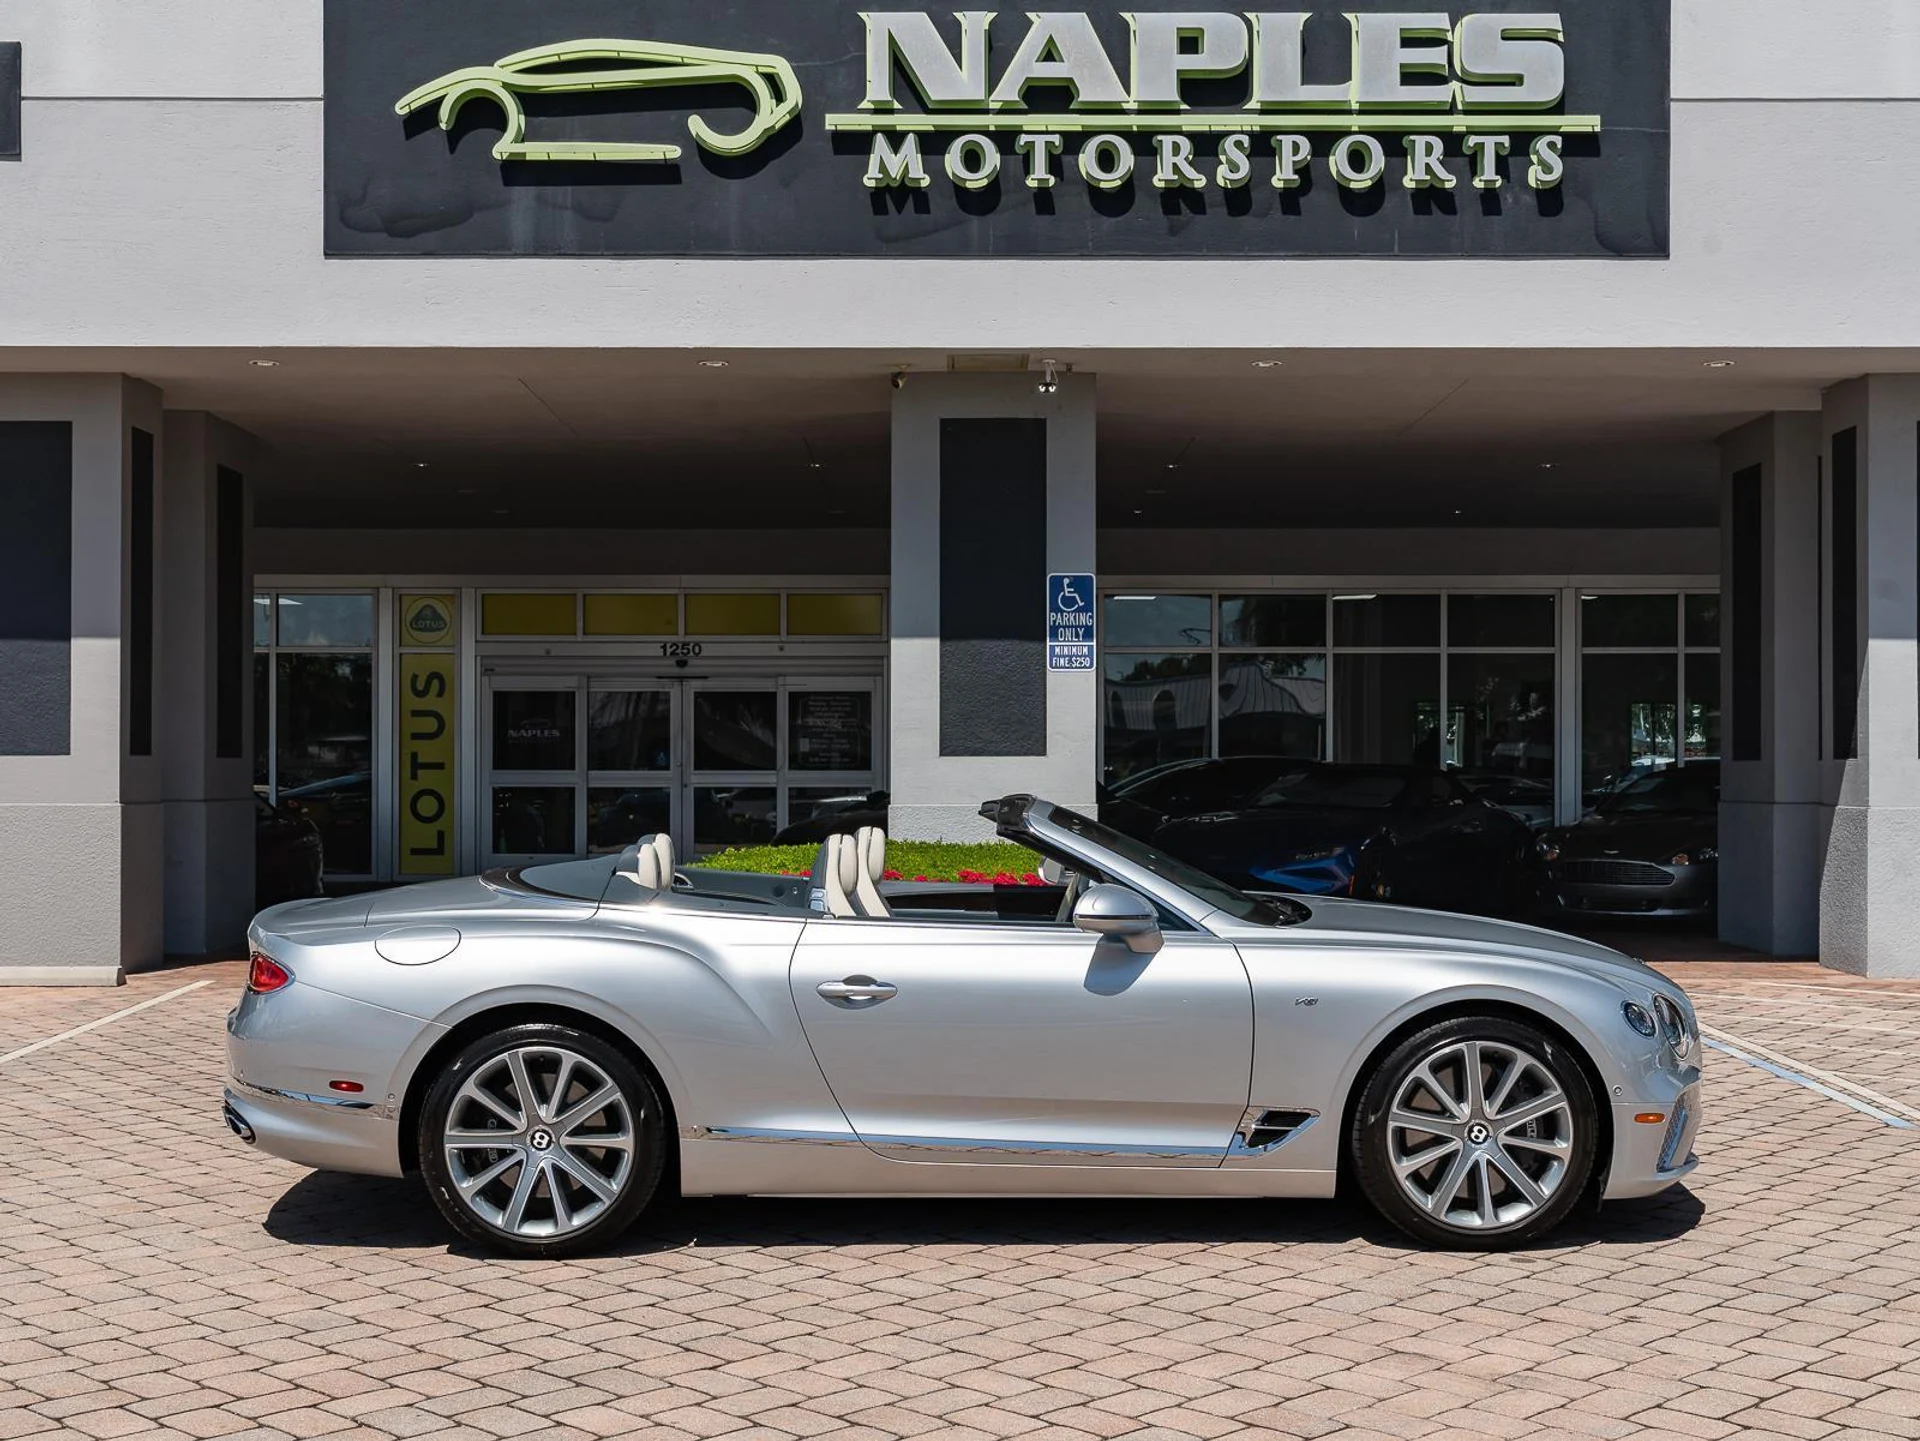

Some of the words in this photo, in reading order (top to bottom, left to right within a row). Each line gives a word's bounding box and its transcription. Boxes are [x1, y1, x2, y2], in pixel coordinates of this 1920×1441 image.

[859, 11, 1565, 110] NAPLES
[862, 132, 1564, 189] MOTORSPORTS
[413, 620, 445, 629] LOTUS
[1050, 612, 1093, 626] PARKING
[1058, 627, 1085, 641] ONLY
[660, 642, 702, 657] 1250
[1054, 645, 1088, 655] MINIMUM
[507, 729, 561, 738] NAPLES
[410, 670, 446, 856] LOTUS
